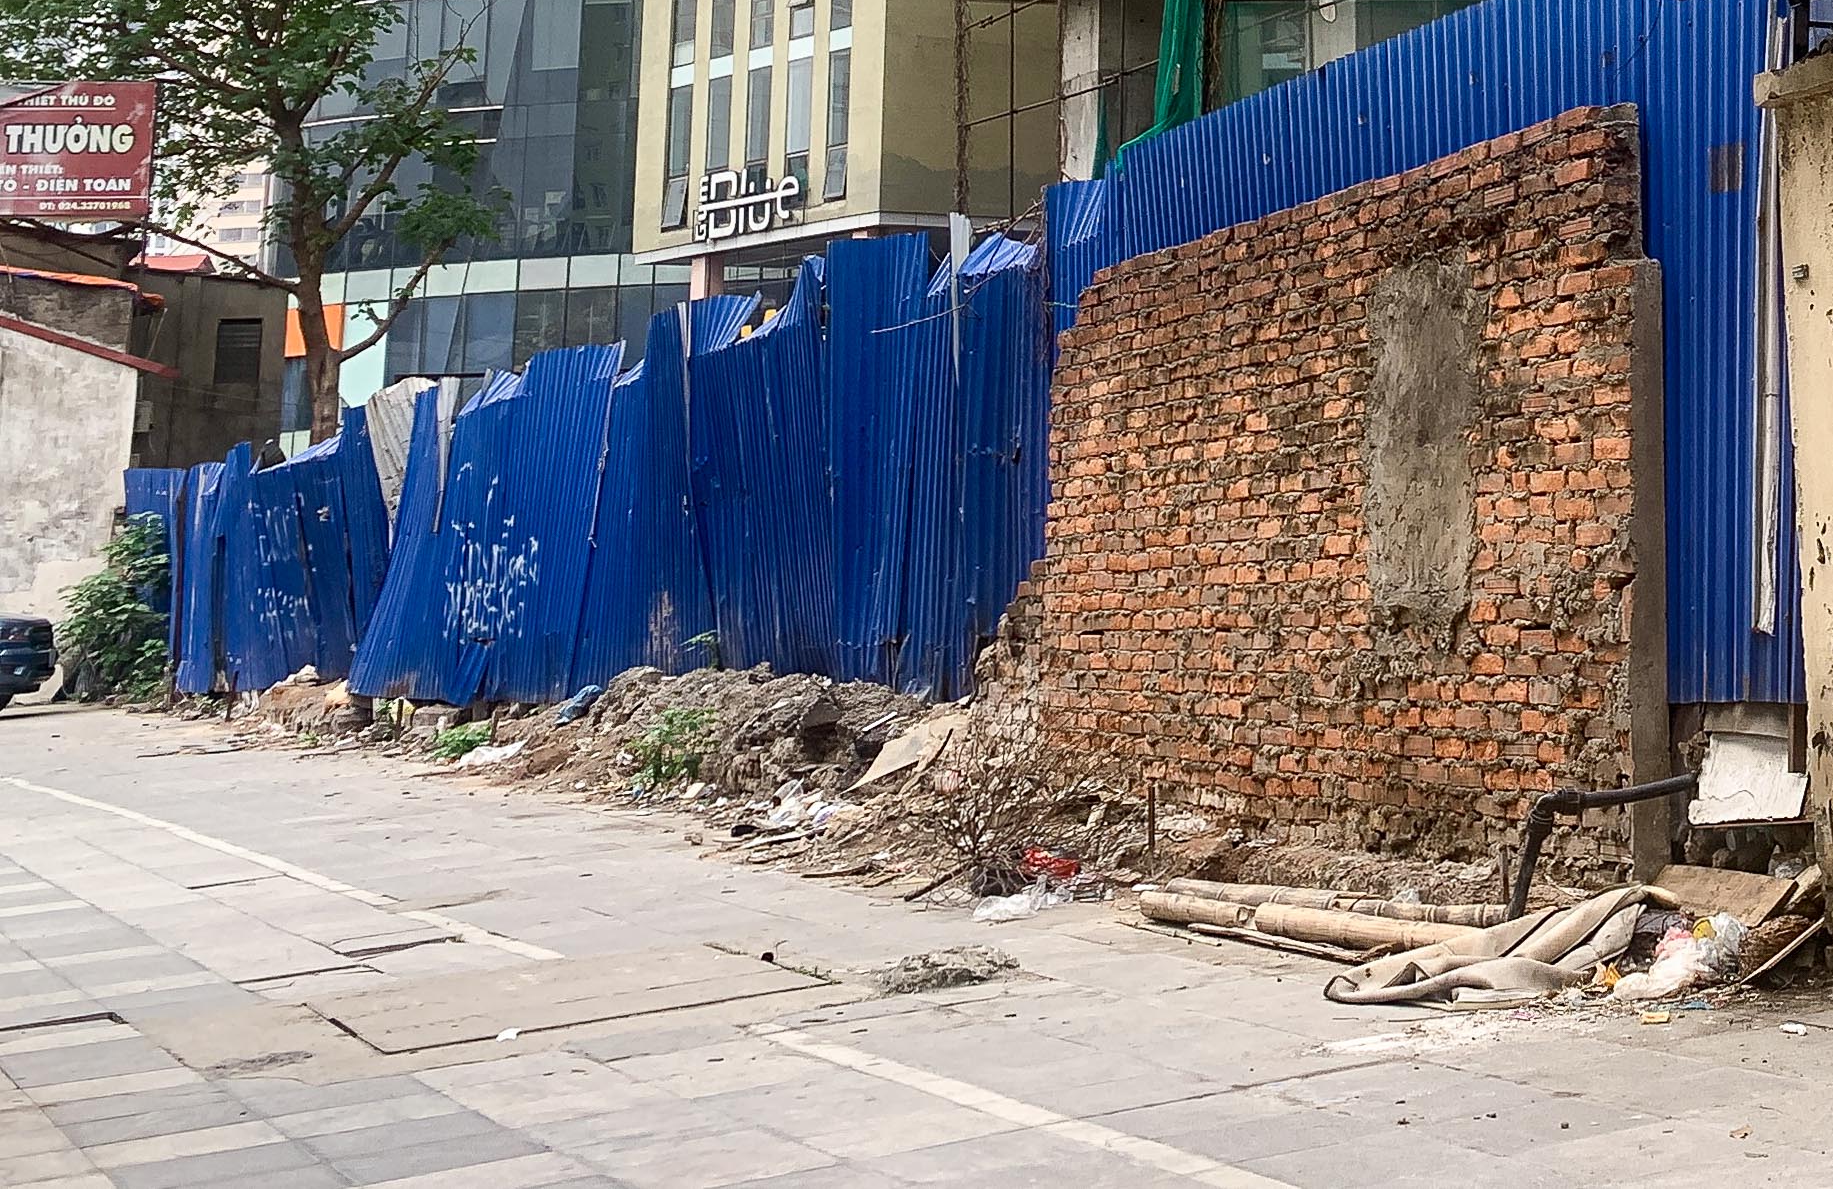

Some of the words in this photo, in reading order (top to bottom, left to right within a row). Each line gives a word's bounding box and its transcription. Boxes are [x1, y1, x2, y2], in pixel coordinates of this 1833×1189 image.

[5, 115, 134, 154] THƯỞNG
[36, 177, 78, 195] ĐIỆN
[83, 176, 131, 192] TOÁN
